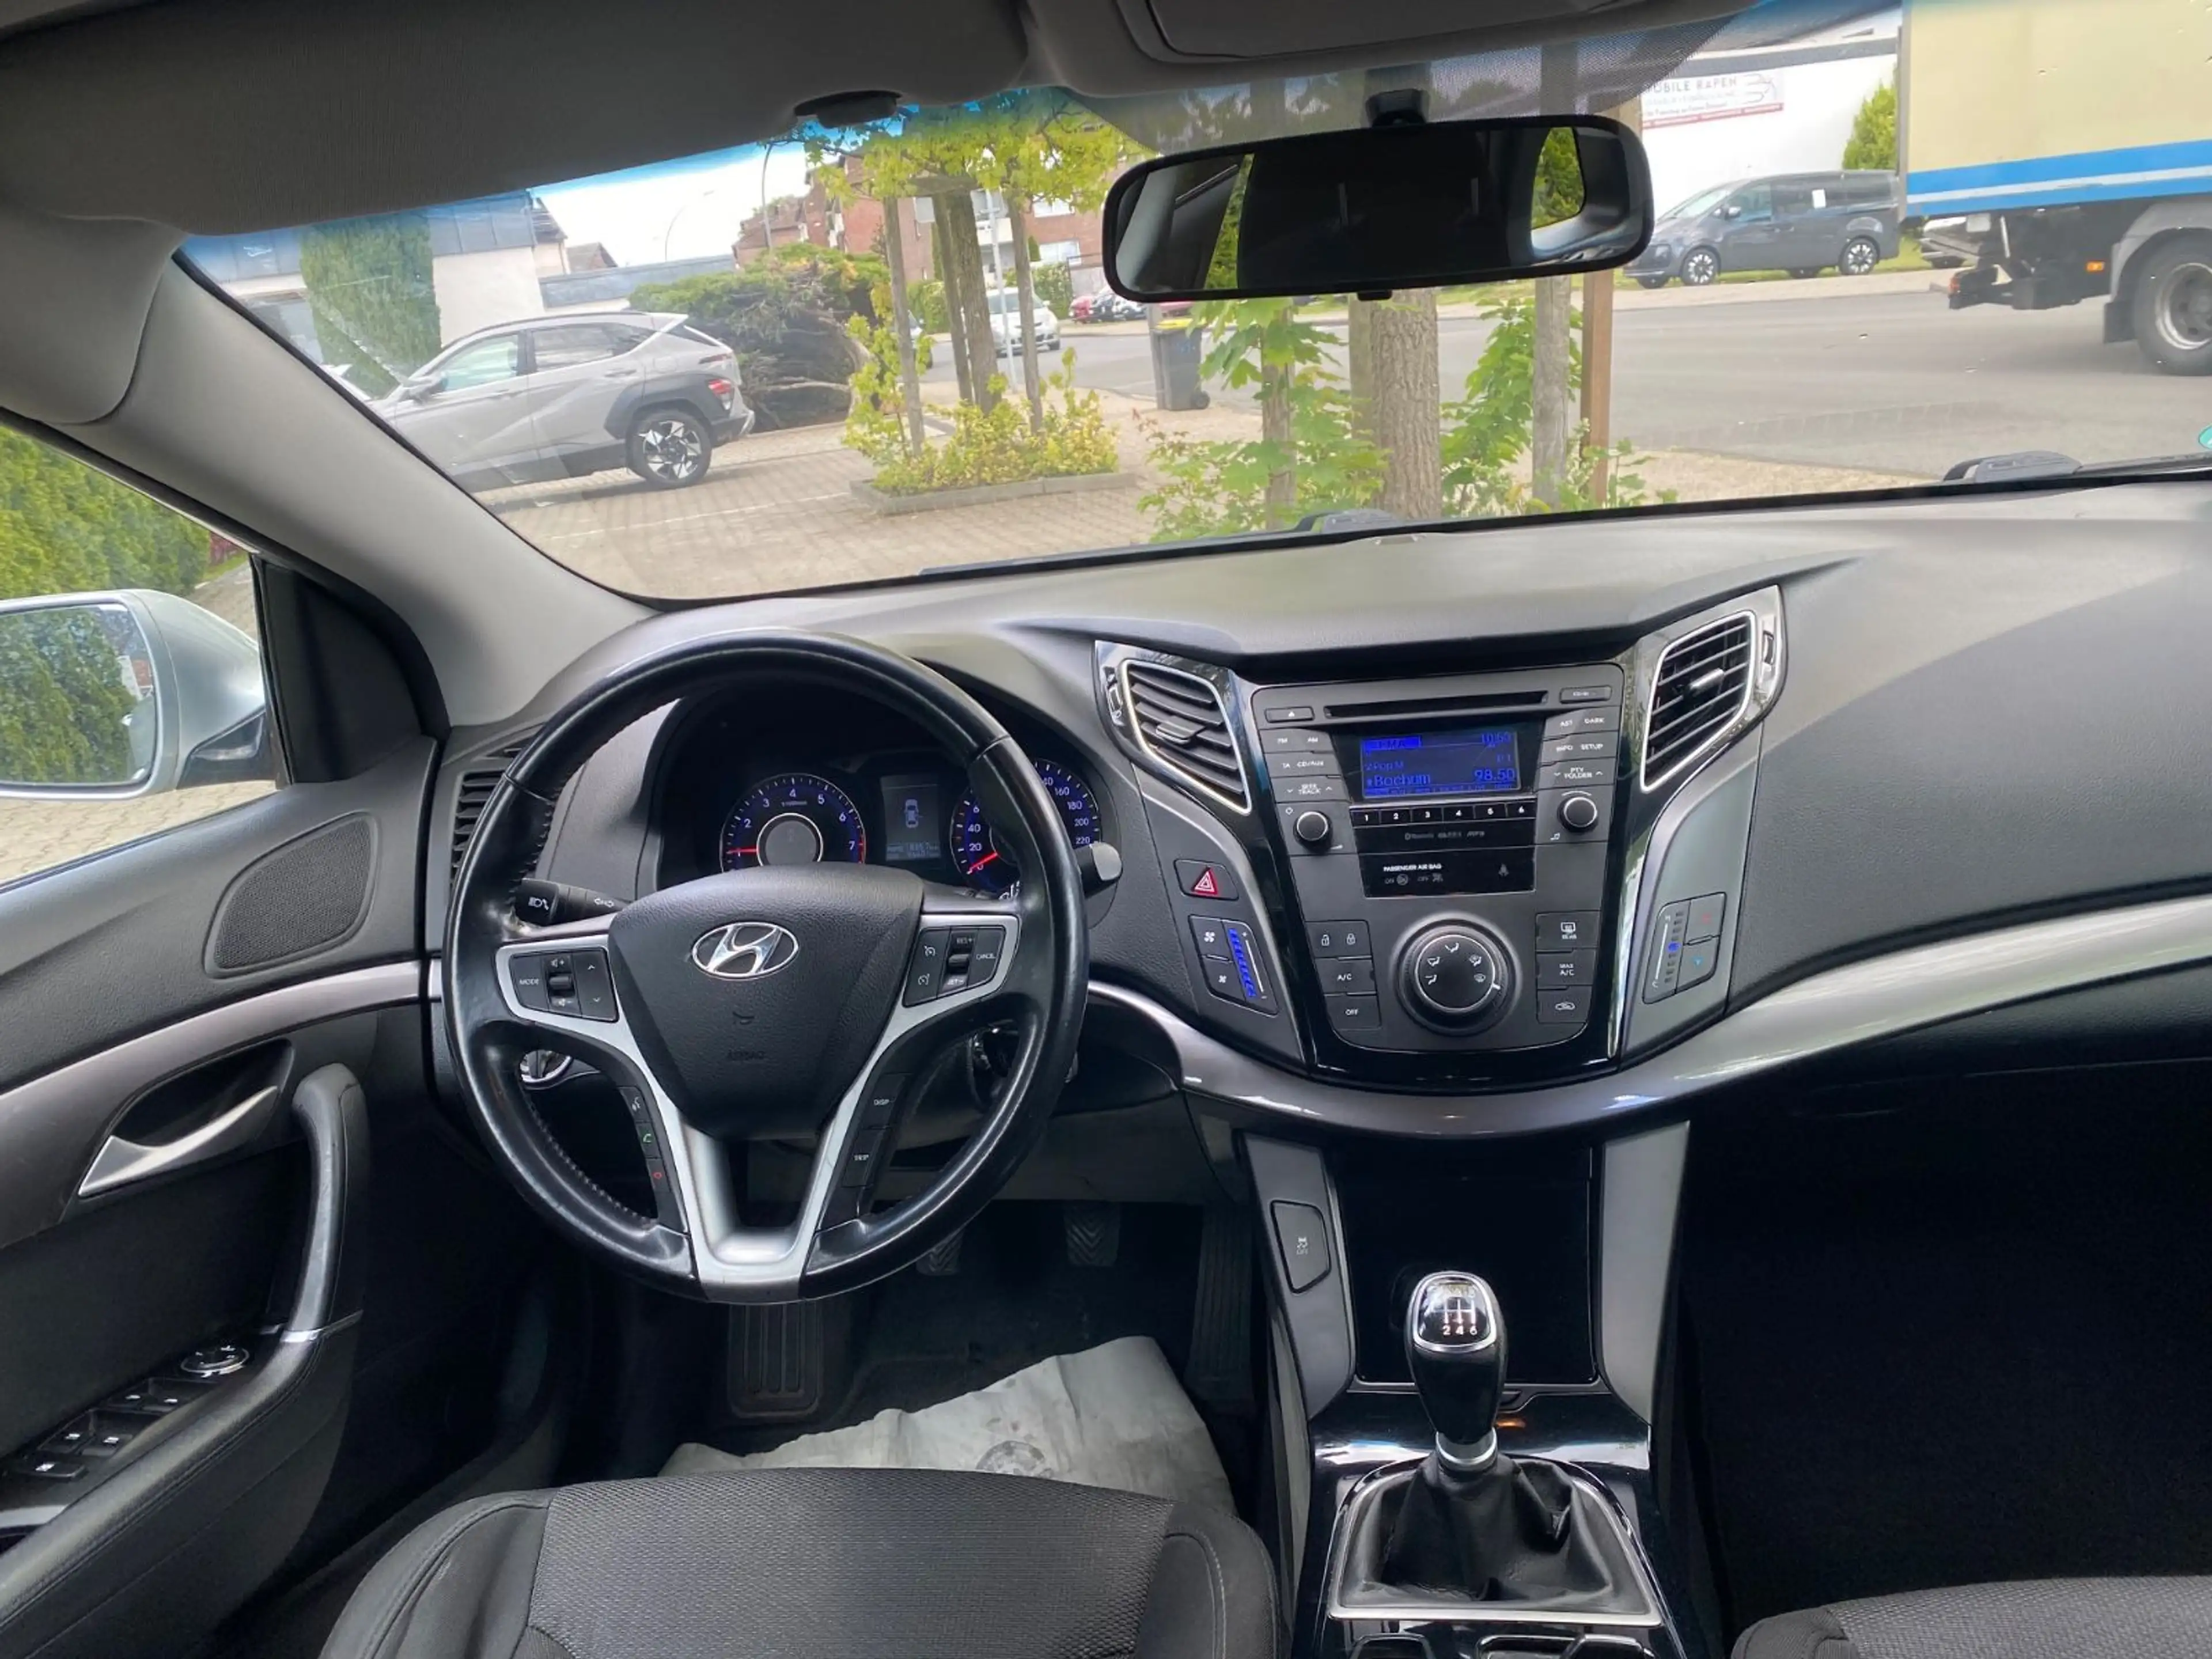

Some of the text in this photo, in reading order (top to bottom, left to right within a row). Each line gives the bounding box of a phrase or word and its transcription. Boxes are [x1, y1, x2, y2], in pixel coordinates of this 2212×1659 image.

[1580, 743, 1604, 751] SETUP
[1297, 760, 1324, 768] CD/AUX
[1474, 767, 1515, 782] 98.50
[1041, 776, 1054, 787] 40
[1374, 774, 1431, 787] Bochum
[789, 788, 797, 798] 4
[1055, 786, 1070, 796] 160
[763, 798, 771, 808] 3
[817, 794, 825, 805] 5
[1067, 800, 1083, 810] 180
[839, 812, 847, 822] 6
[1363, 813, 1369, 823] 1
[1392, 812, 1400, 820] 2
[1424, 810, 1431, 819] 3
[1487, 807, 1494, 815] 5
[1518, 805, 1525, 814] 6
[743, 818, 752, 828] 2
[1074, 817, 1089, 827] 200
[967, 823, 981, 833] 40
[1075, 836, 1090, 844] 220
[848, 840, 855, 851] 7
[969, 842, 983, 851] 20
[1383, 864, 1416, 872] PASSENGER
[975, 952, 997, 961] CANCEL
[1336, 973, 1353, 982] A/C
[1344, 1008, 1359, 1016] OFF
[1442, 1325, 1478, 1336] 2 4 6
